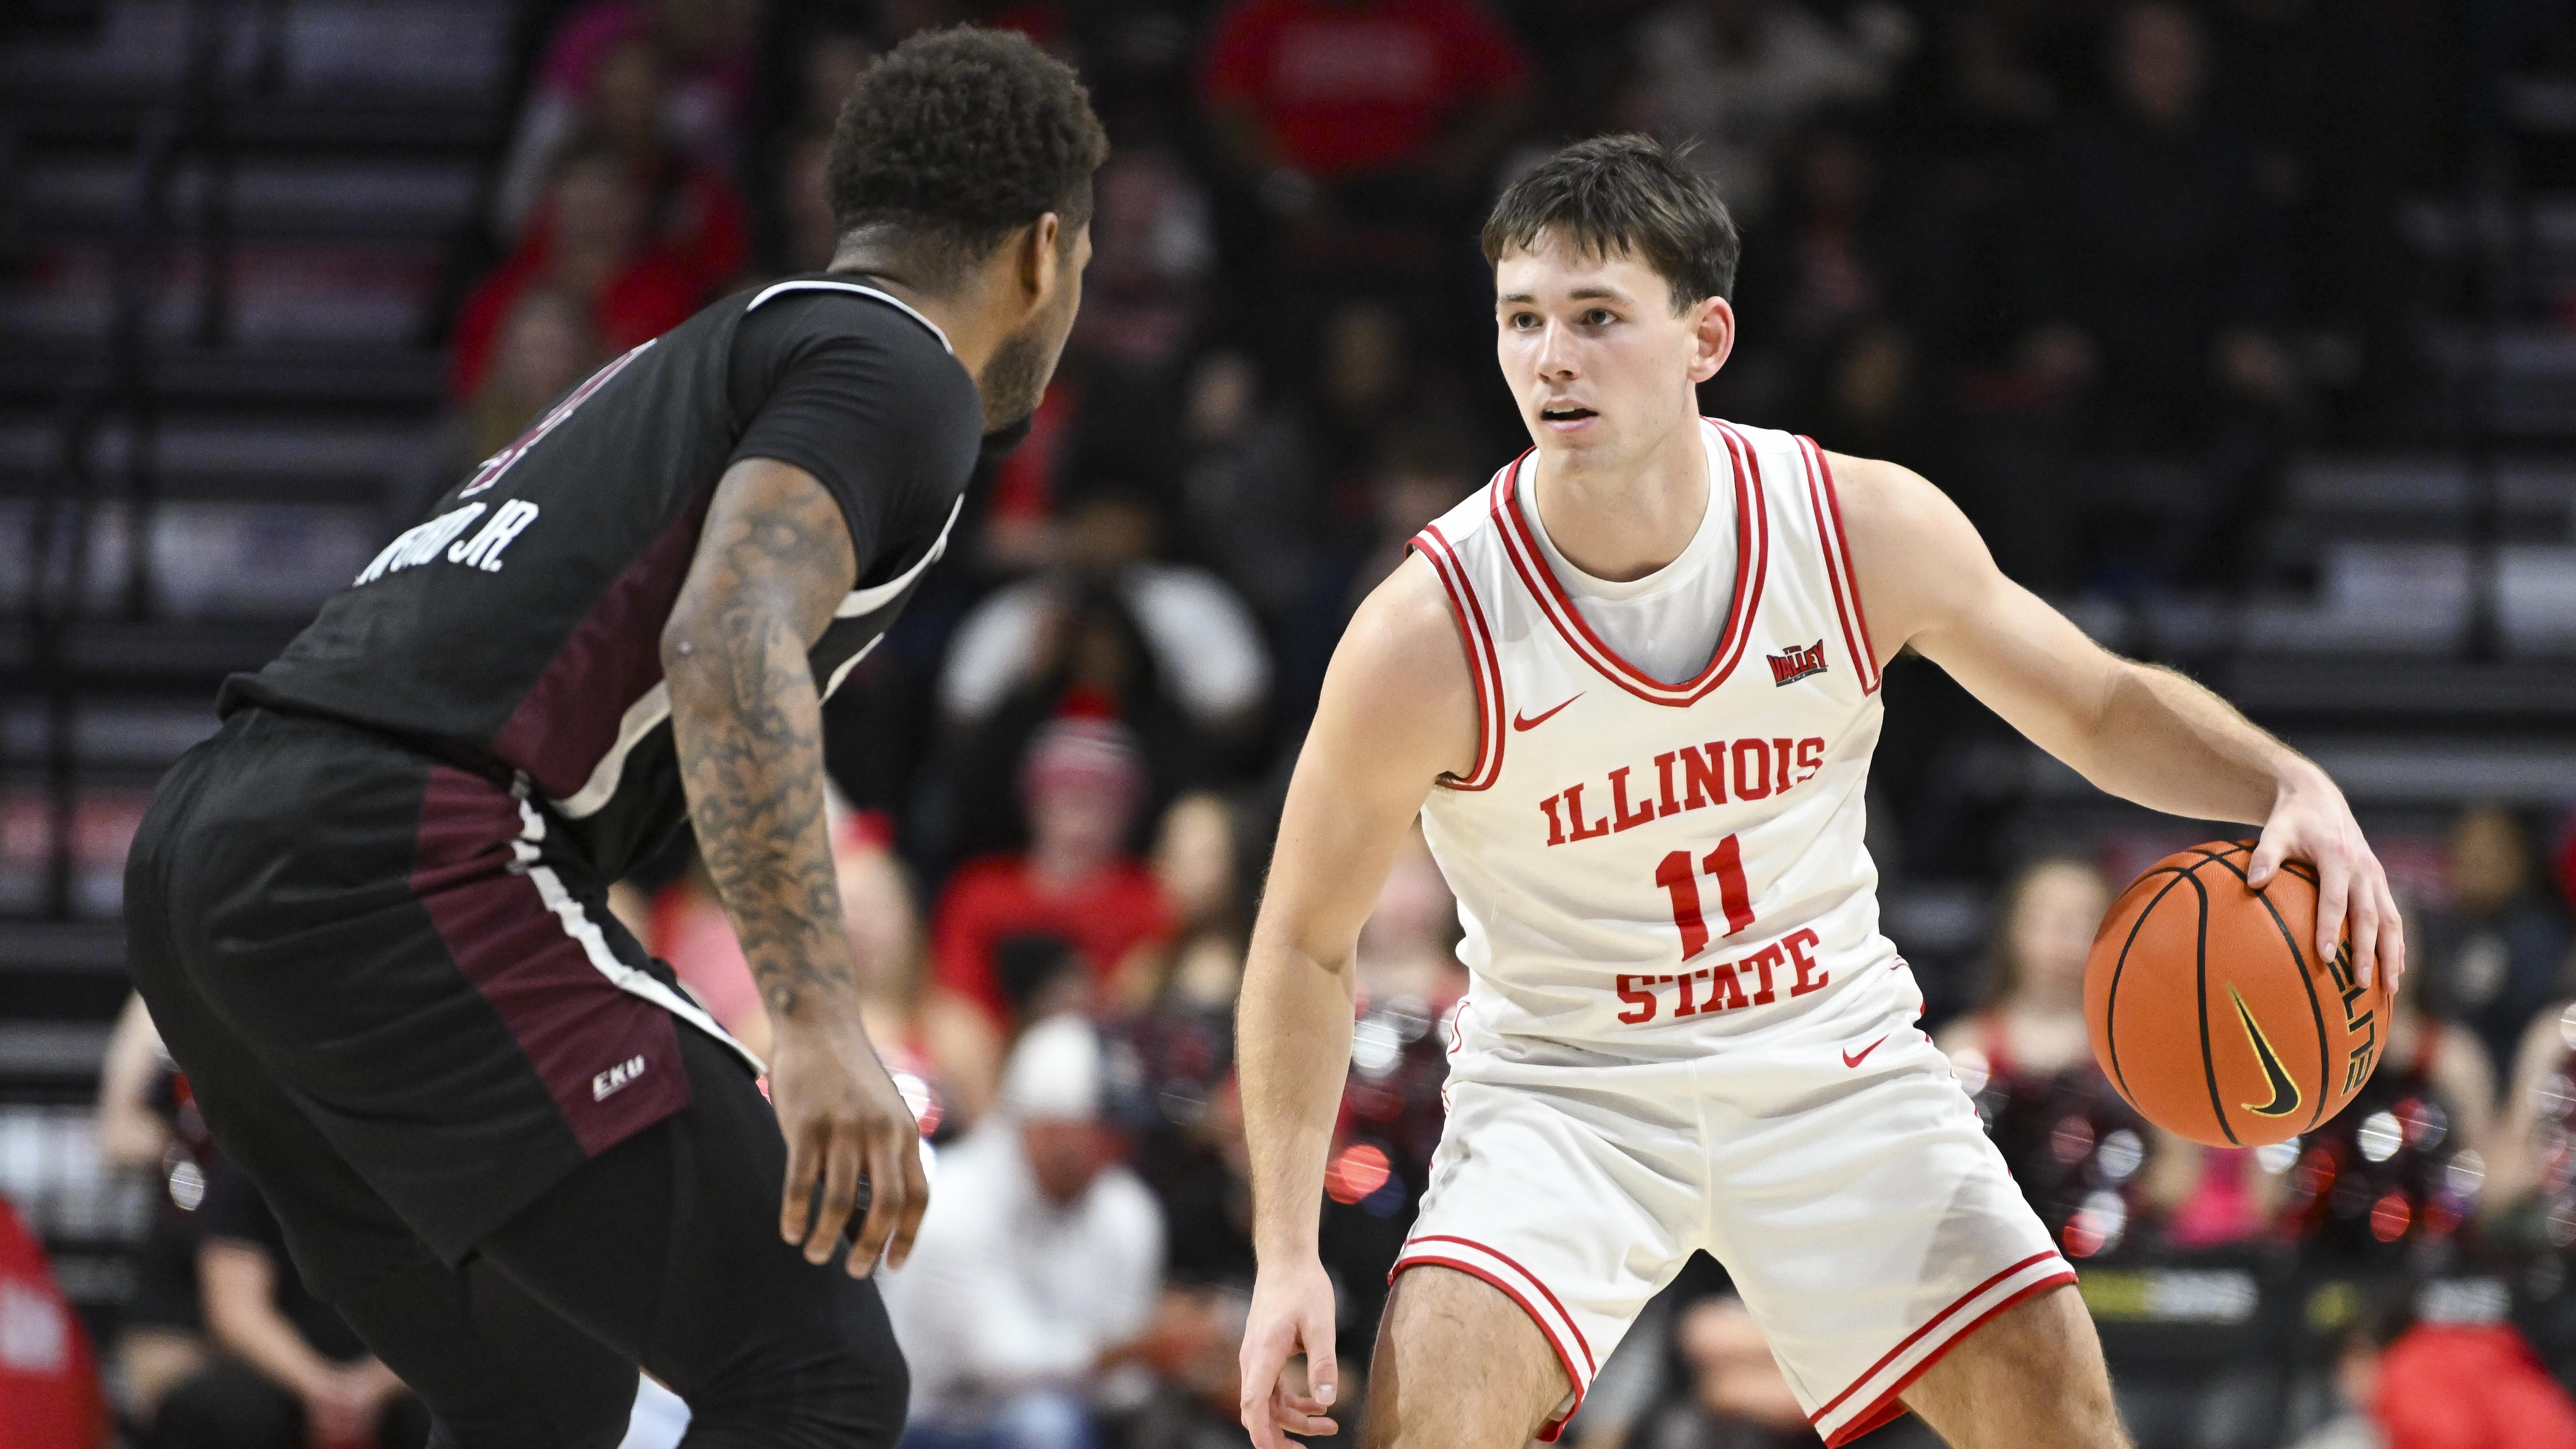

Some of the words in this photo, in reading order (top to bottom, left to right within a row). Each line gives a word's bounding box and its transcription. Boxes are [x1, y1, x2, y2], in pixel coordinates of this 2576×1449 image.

[1767, 639, 1826, 682] VALLEY
[1540, 737, 1825, 846] ILLINOIS
[1655, 833, 1755, 962] 11
[1617, 928, 1828, 1025] STATE
[2327, 940, 2376, 1097] ELITE
[593, 1054, 645, 1102] EKU
